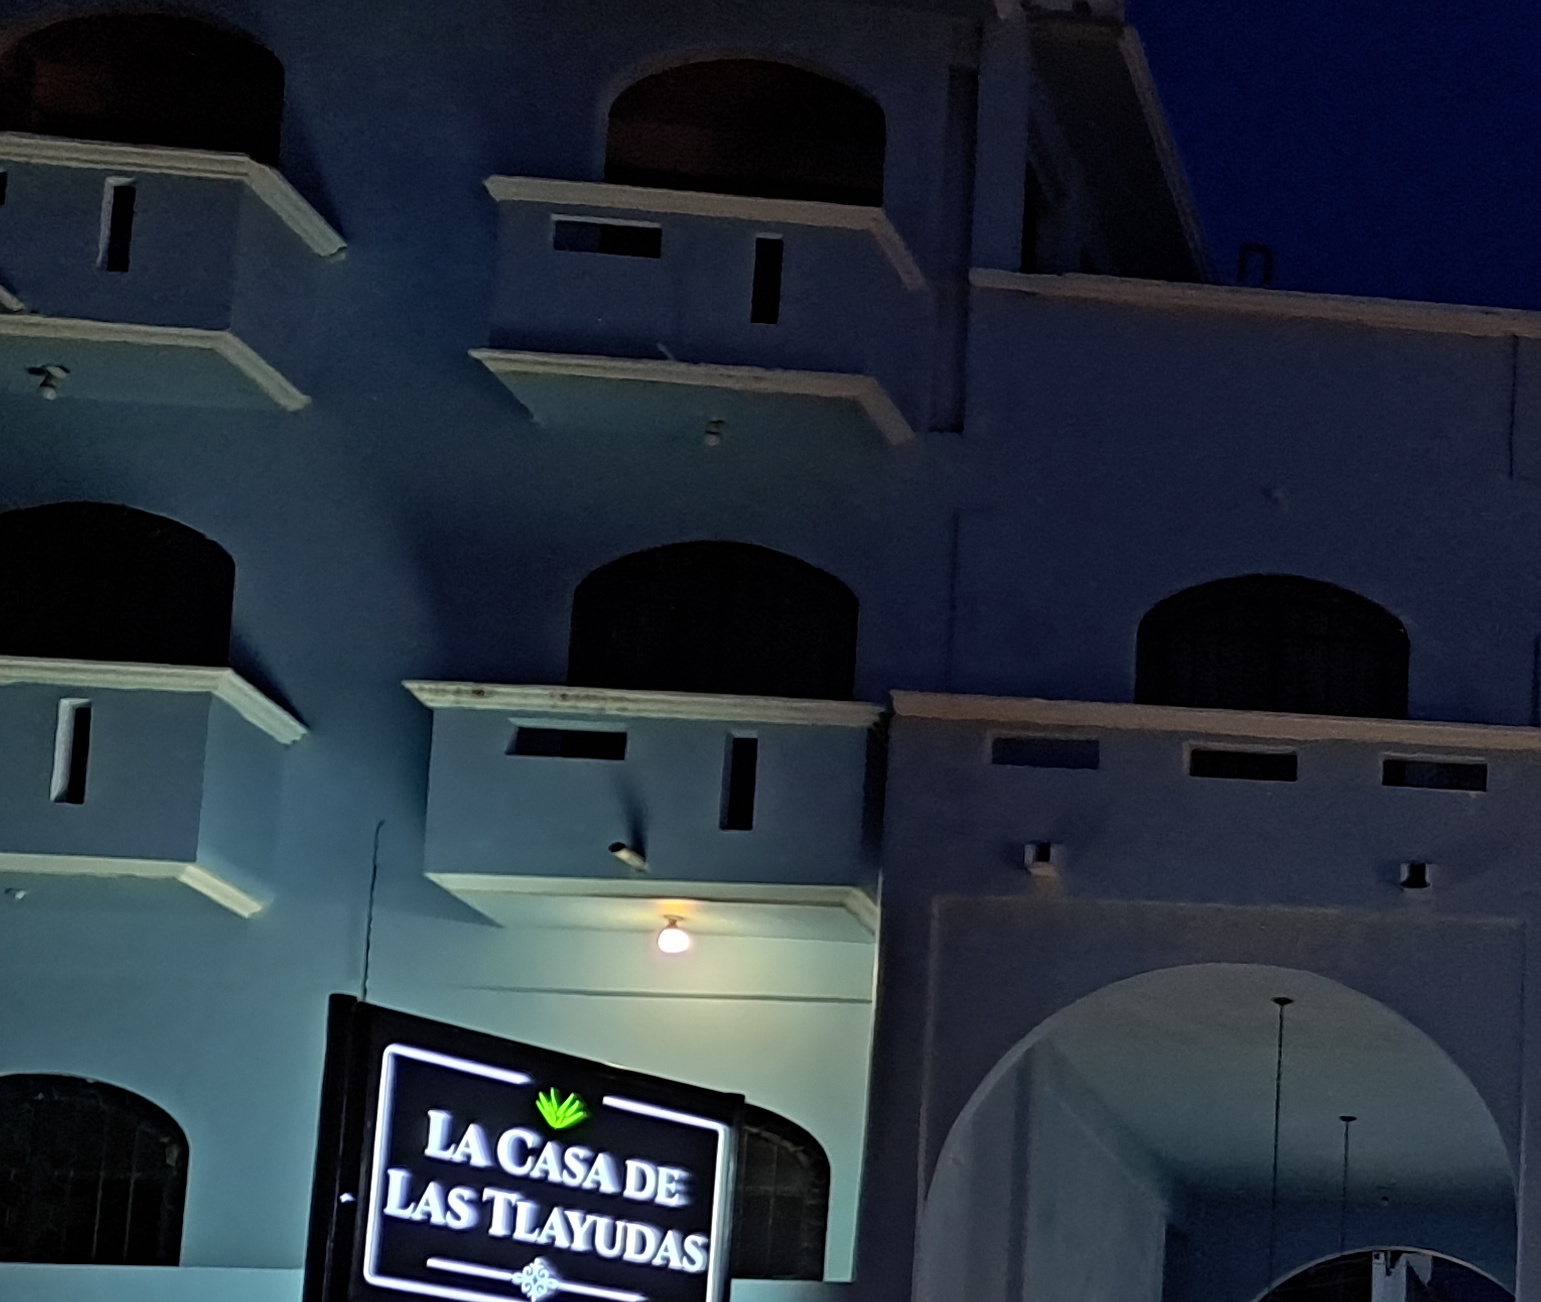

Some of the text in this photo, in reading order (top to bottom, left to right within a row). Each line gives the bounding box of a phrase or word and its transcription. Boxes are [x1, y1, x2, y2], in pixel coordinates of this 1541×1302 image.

[424, 1109, 691, 1207] LA CASA DE
[384, 1169, 709, 1273] LAS TLAYUDAS
